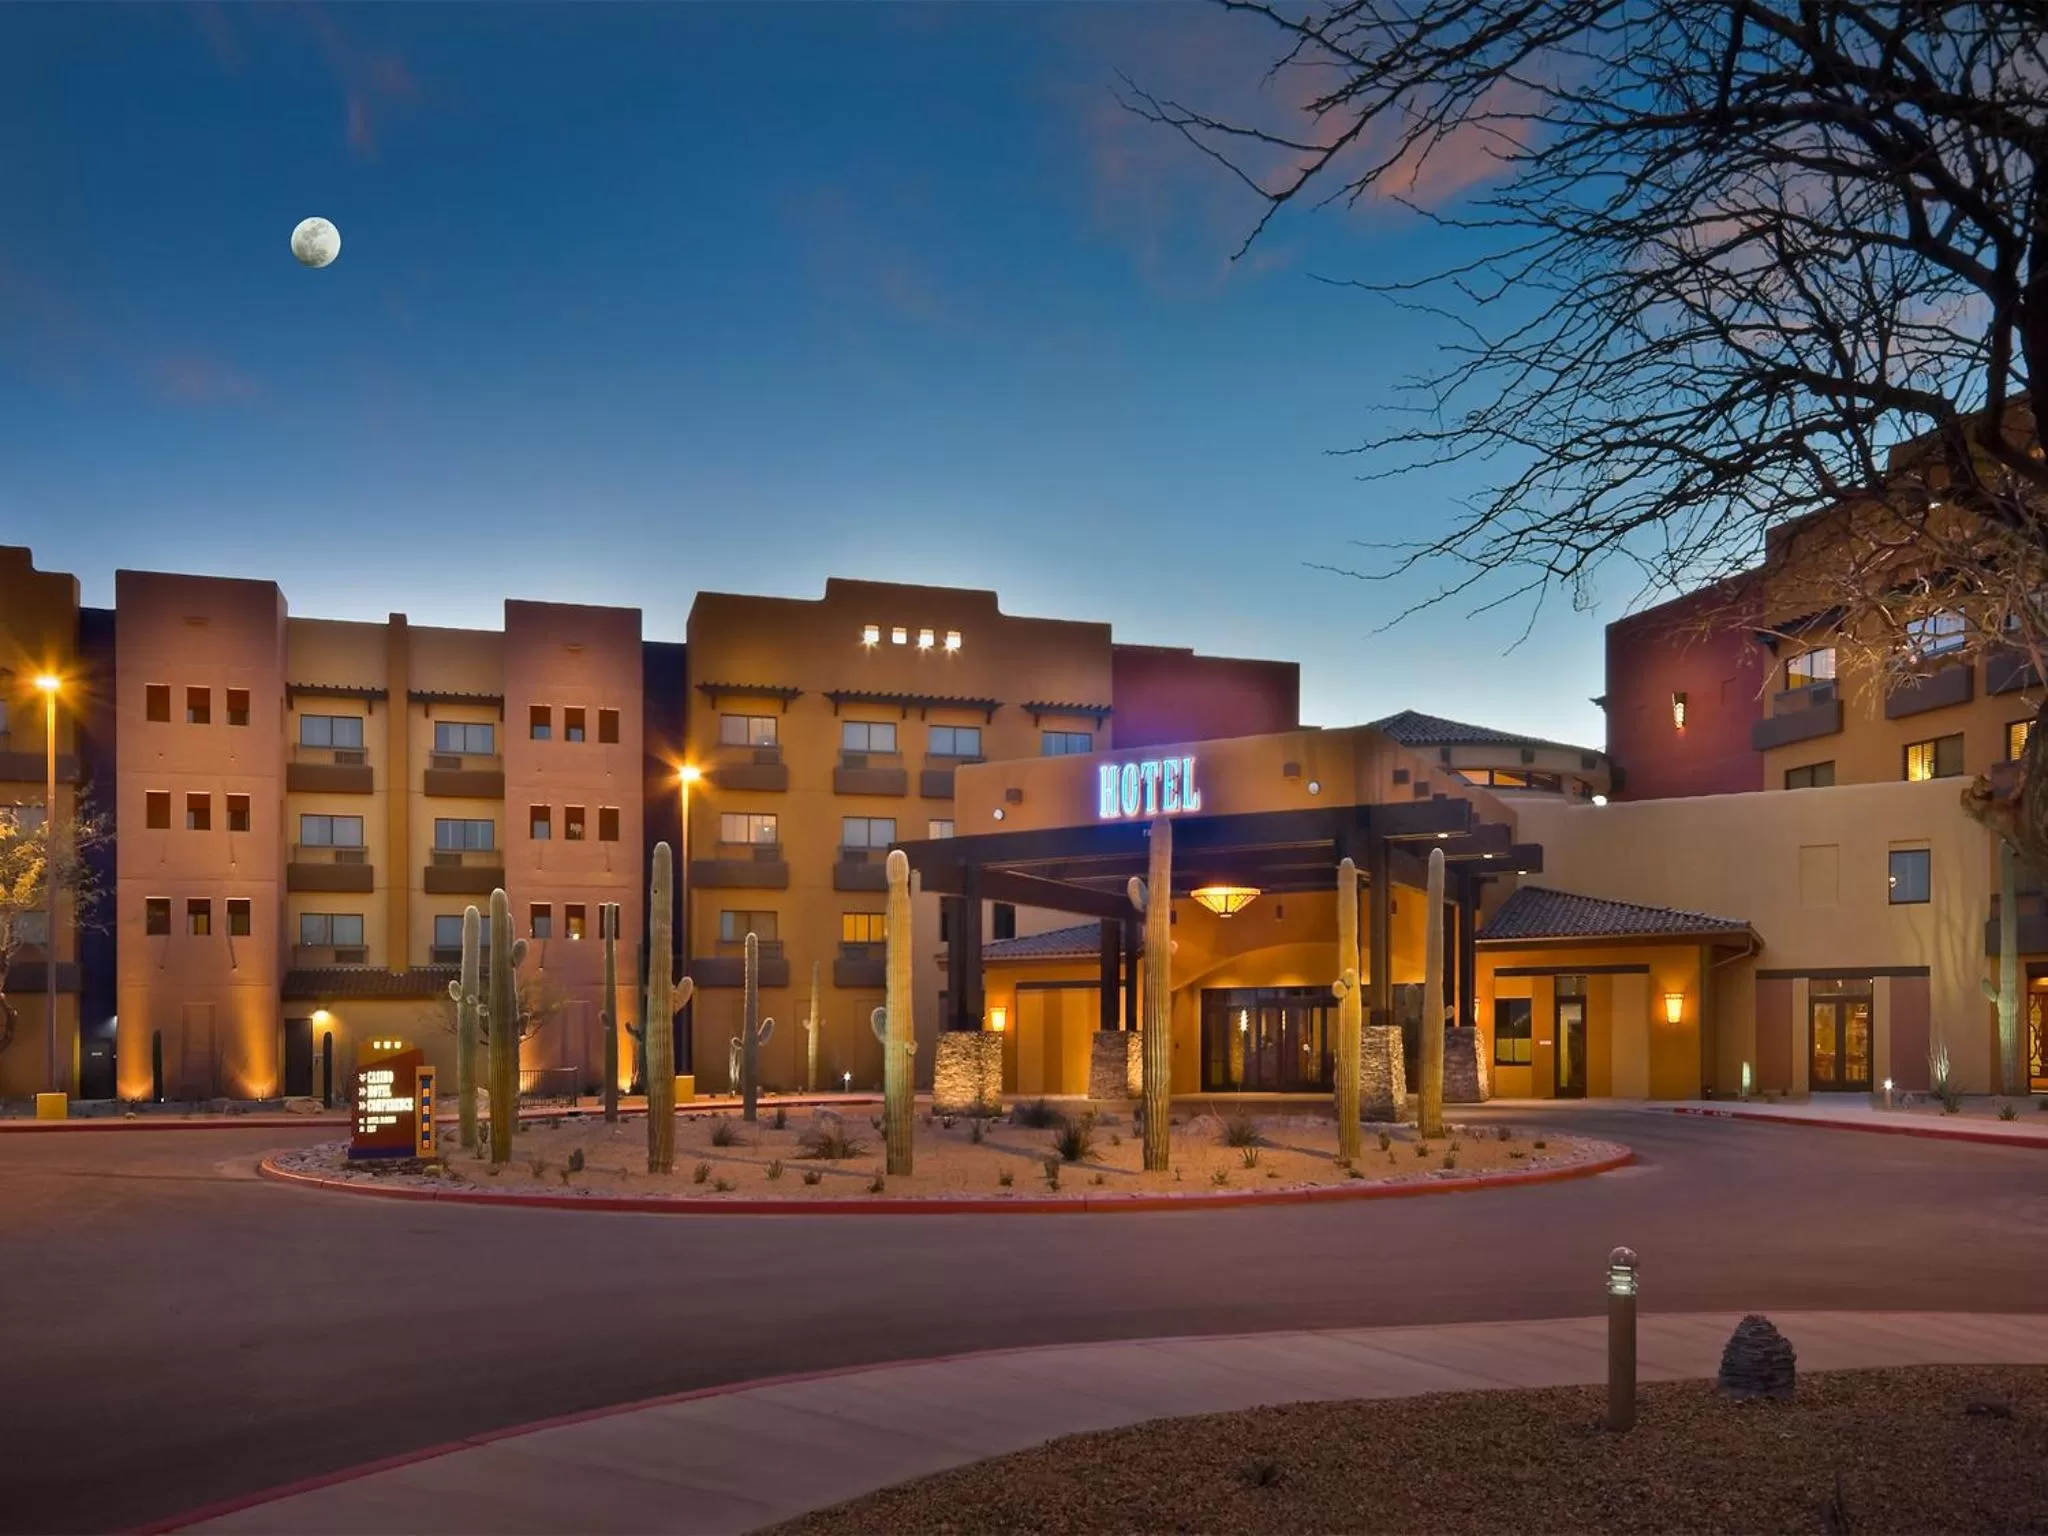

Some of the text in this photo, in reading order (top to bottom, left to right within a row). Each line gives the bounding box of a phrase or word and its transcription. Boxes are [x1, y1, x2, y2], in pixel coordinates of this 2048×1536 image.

[1099, 757, 1201, 818] HOTEL
[367, 1071, 394, 1083] CASINO
[367, 1085, 391, 1097] HOTEL
